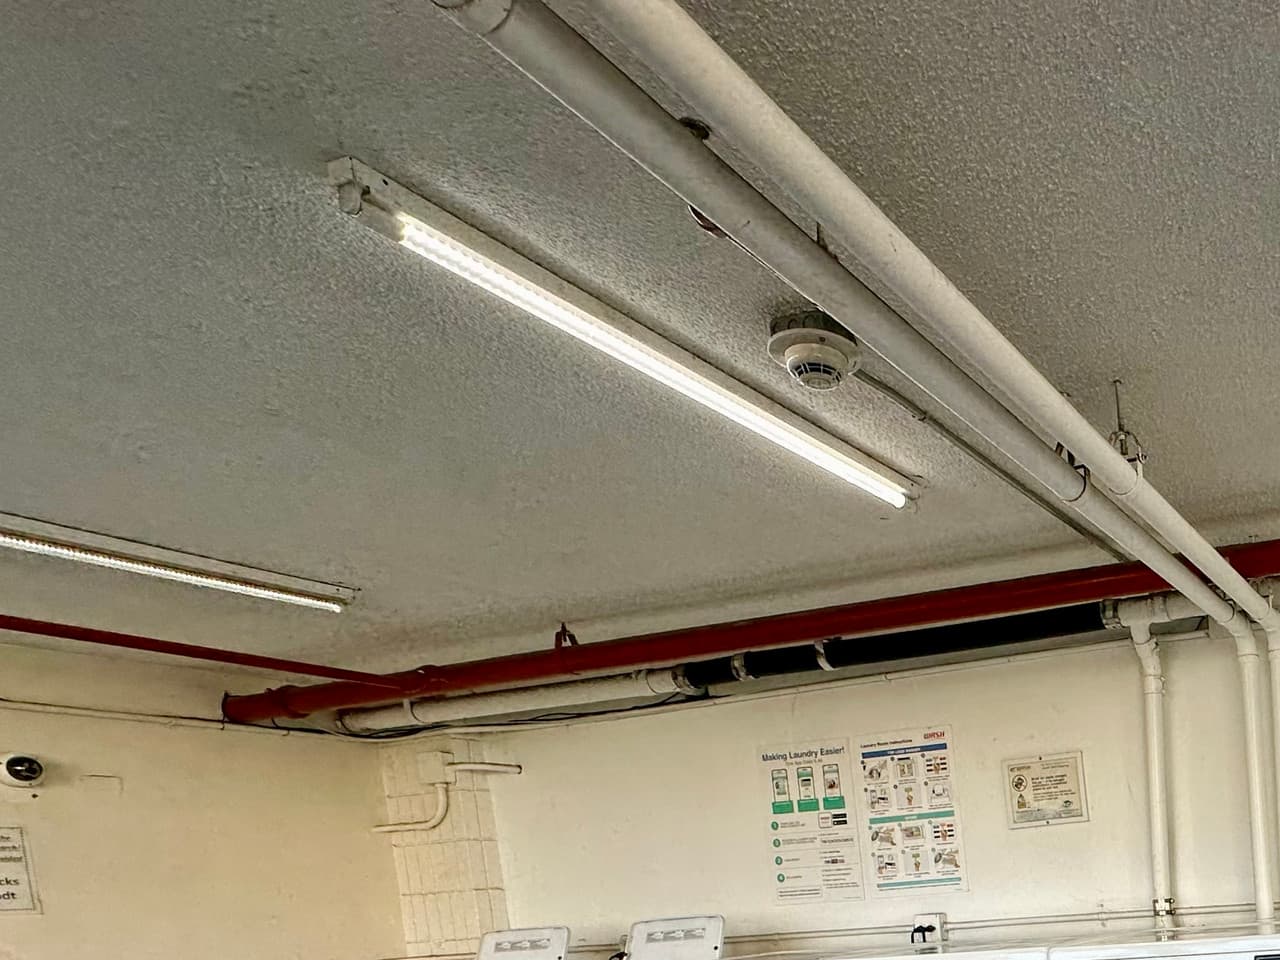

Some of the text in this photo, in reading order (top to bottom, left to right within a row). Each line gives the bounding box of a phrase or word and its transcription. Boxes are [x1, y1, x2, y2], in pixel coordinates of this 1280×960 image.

[762, 745, 845, 762] Making Laundry Easier!
